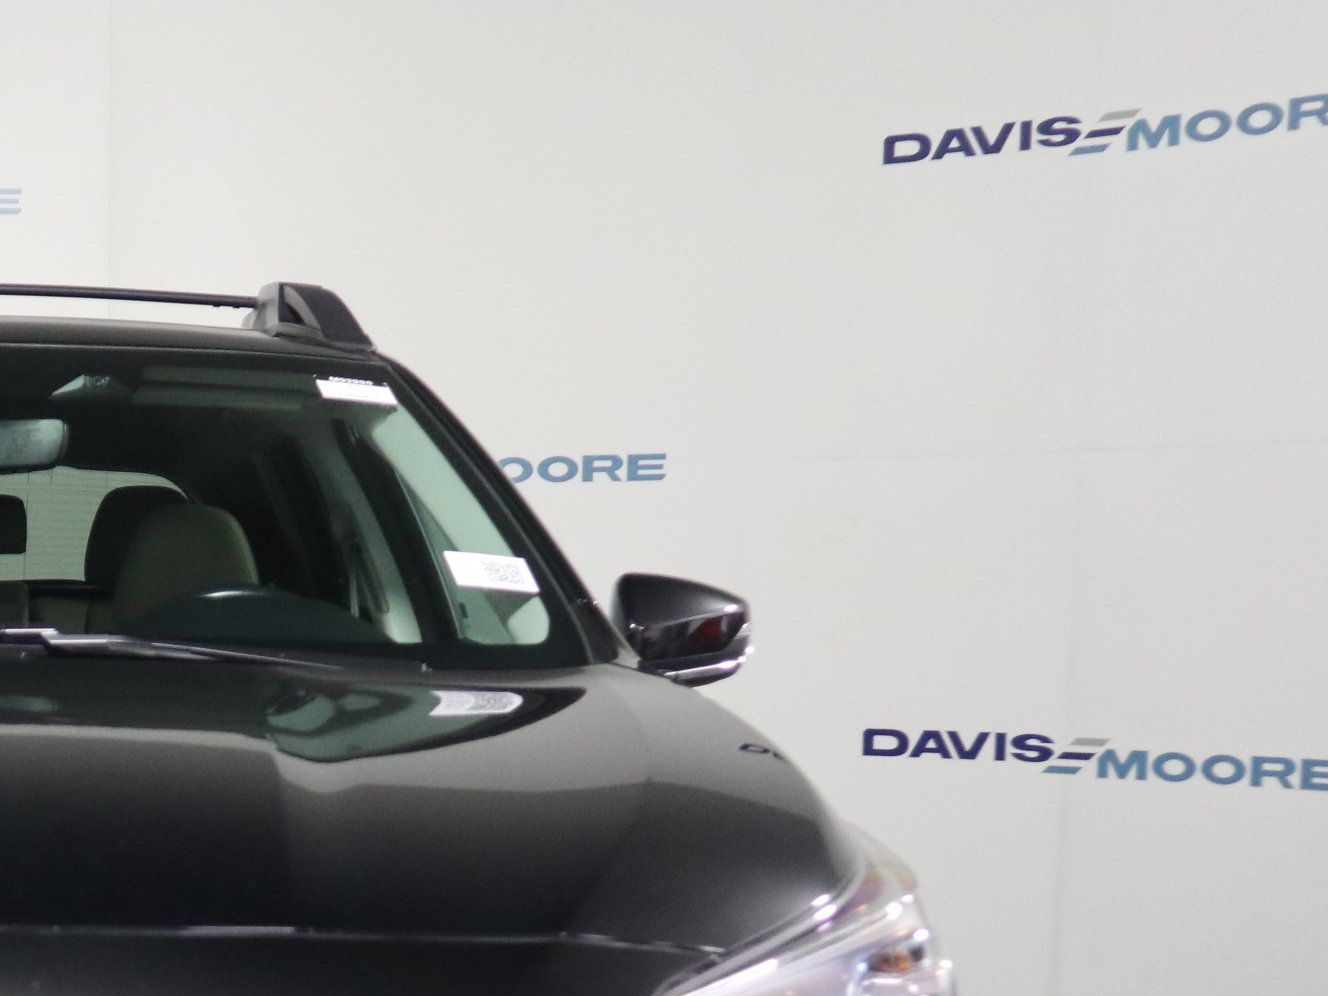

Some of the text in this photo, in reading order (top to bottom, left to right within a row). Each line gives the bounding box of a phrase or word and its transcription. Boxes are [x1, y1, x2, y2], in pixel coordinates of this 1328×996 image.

[883, 116, 1083, 165] DAVIS
[862, 728, 1328, 792] DAVIS MOORE
